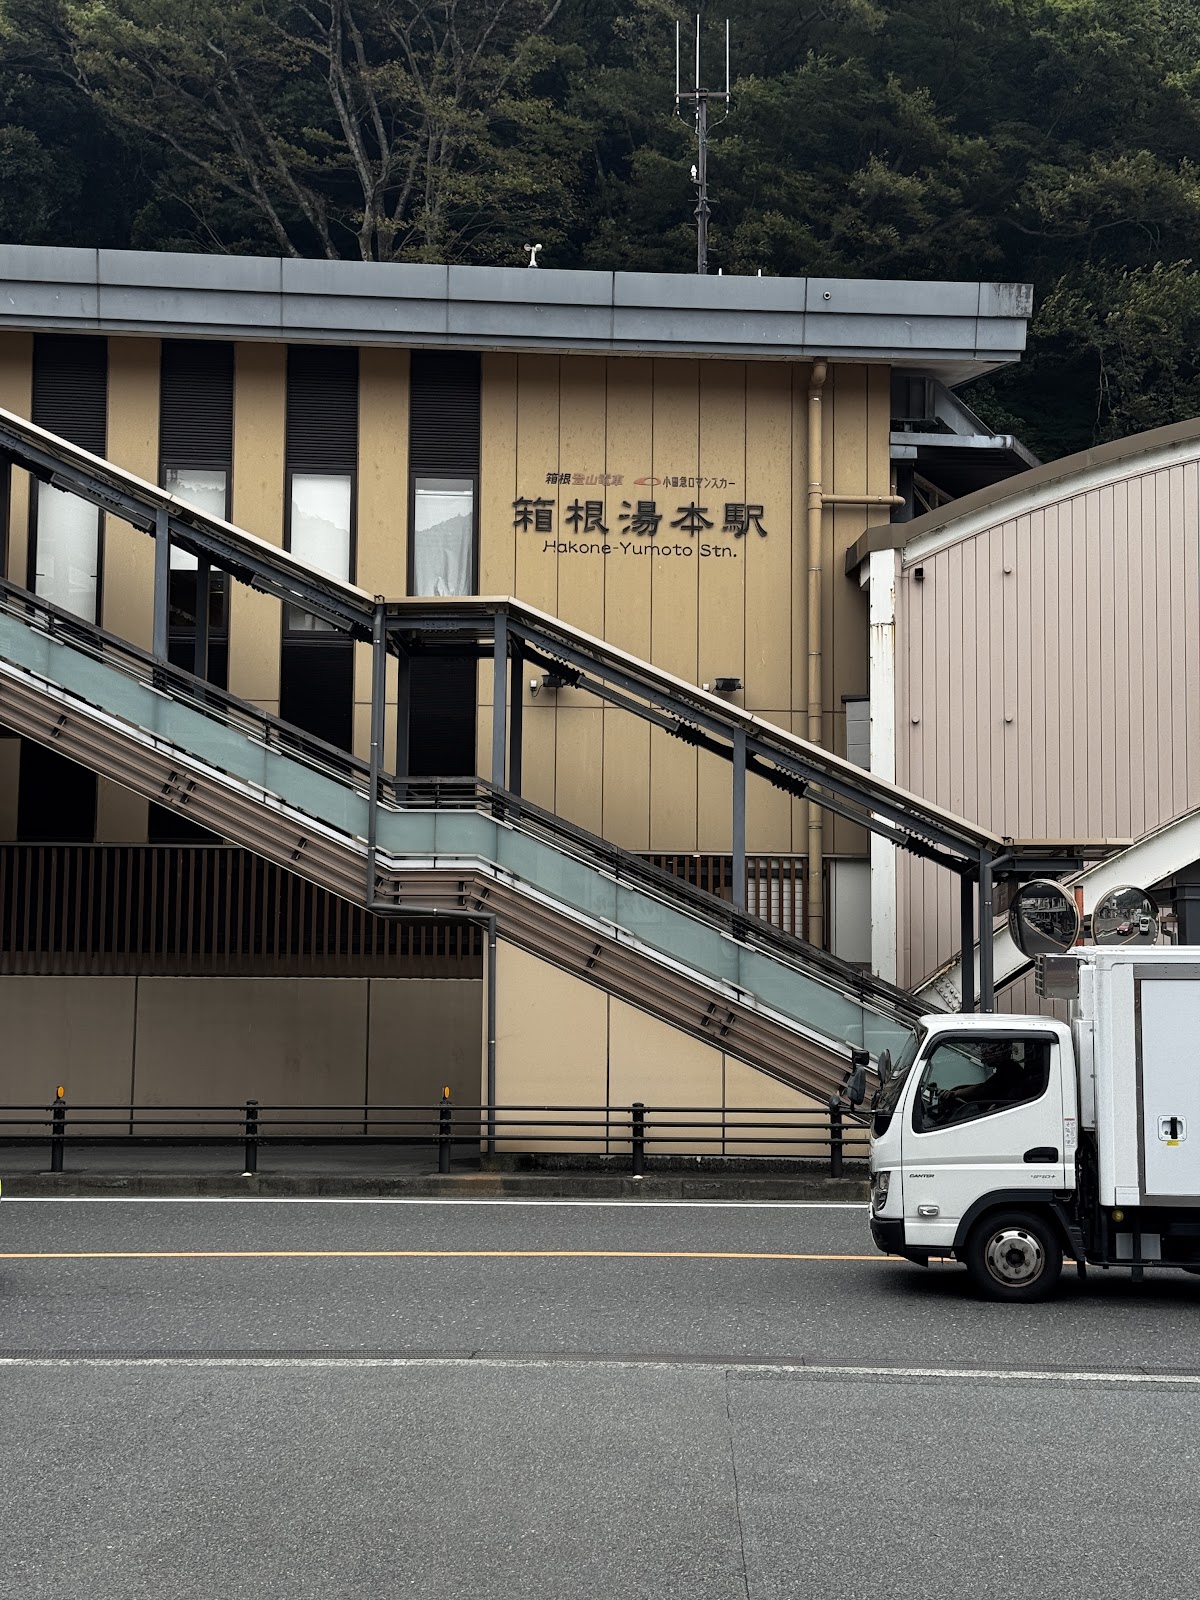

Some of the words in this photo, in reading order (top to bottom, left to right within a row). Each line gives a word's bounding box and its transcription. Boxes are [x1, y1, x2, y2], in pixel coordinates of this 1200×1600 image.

[545, 472, 625, 487] 箱根登山電車
[663, 475, 736, 489] 小田急ロマンスカー
[512, 496, 768, 538] 箱根湯本駅
[542, 540, 693, 557] Hakone-Yumoto
[700, 544, 738, 558] Stn.
